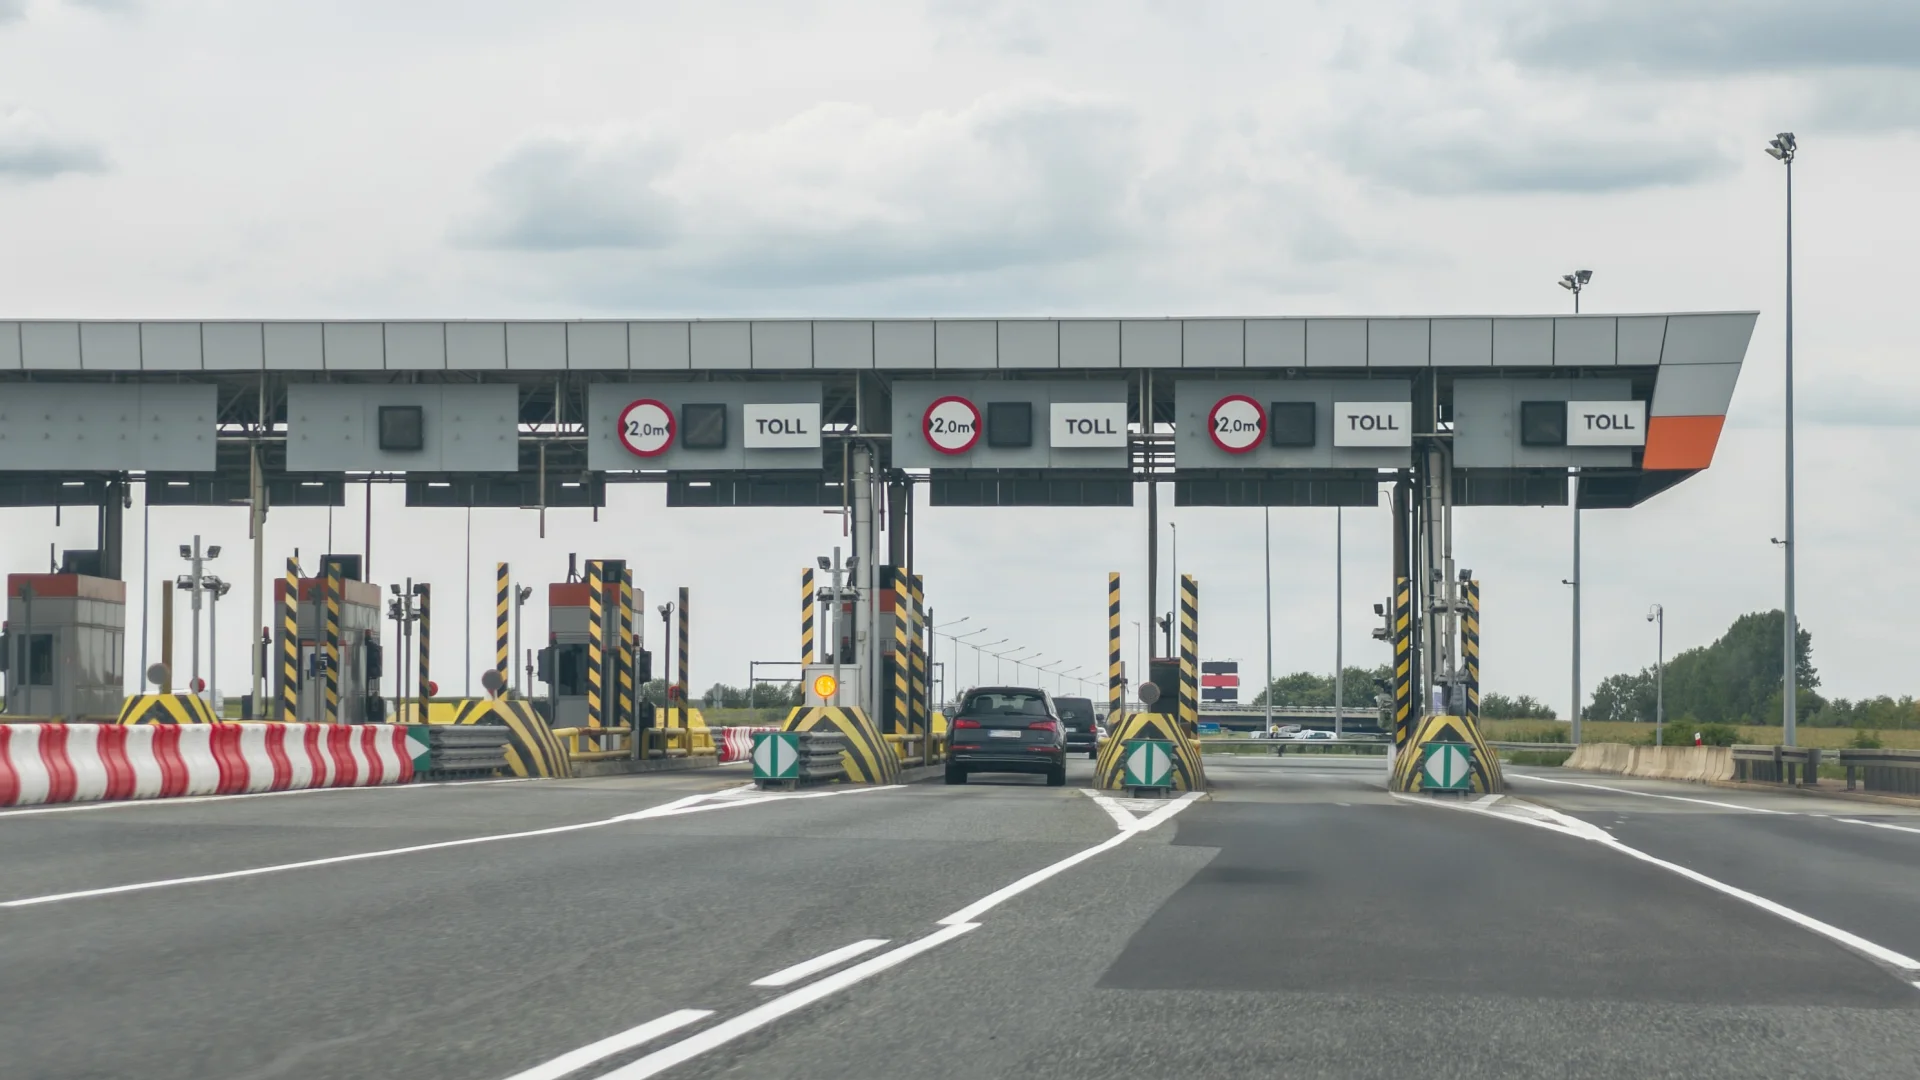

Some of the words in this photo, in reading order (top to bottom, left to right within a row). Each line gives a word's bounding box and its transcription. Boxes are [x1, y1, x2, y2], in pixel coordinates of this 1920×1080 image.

[756, 418, 807, 434] TOLL
[1066, 418, 1117, 434] TOLL
[1348, 414, 1399, 430] TOLL
[1583, 413, 1635, 429] TOLL
